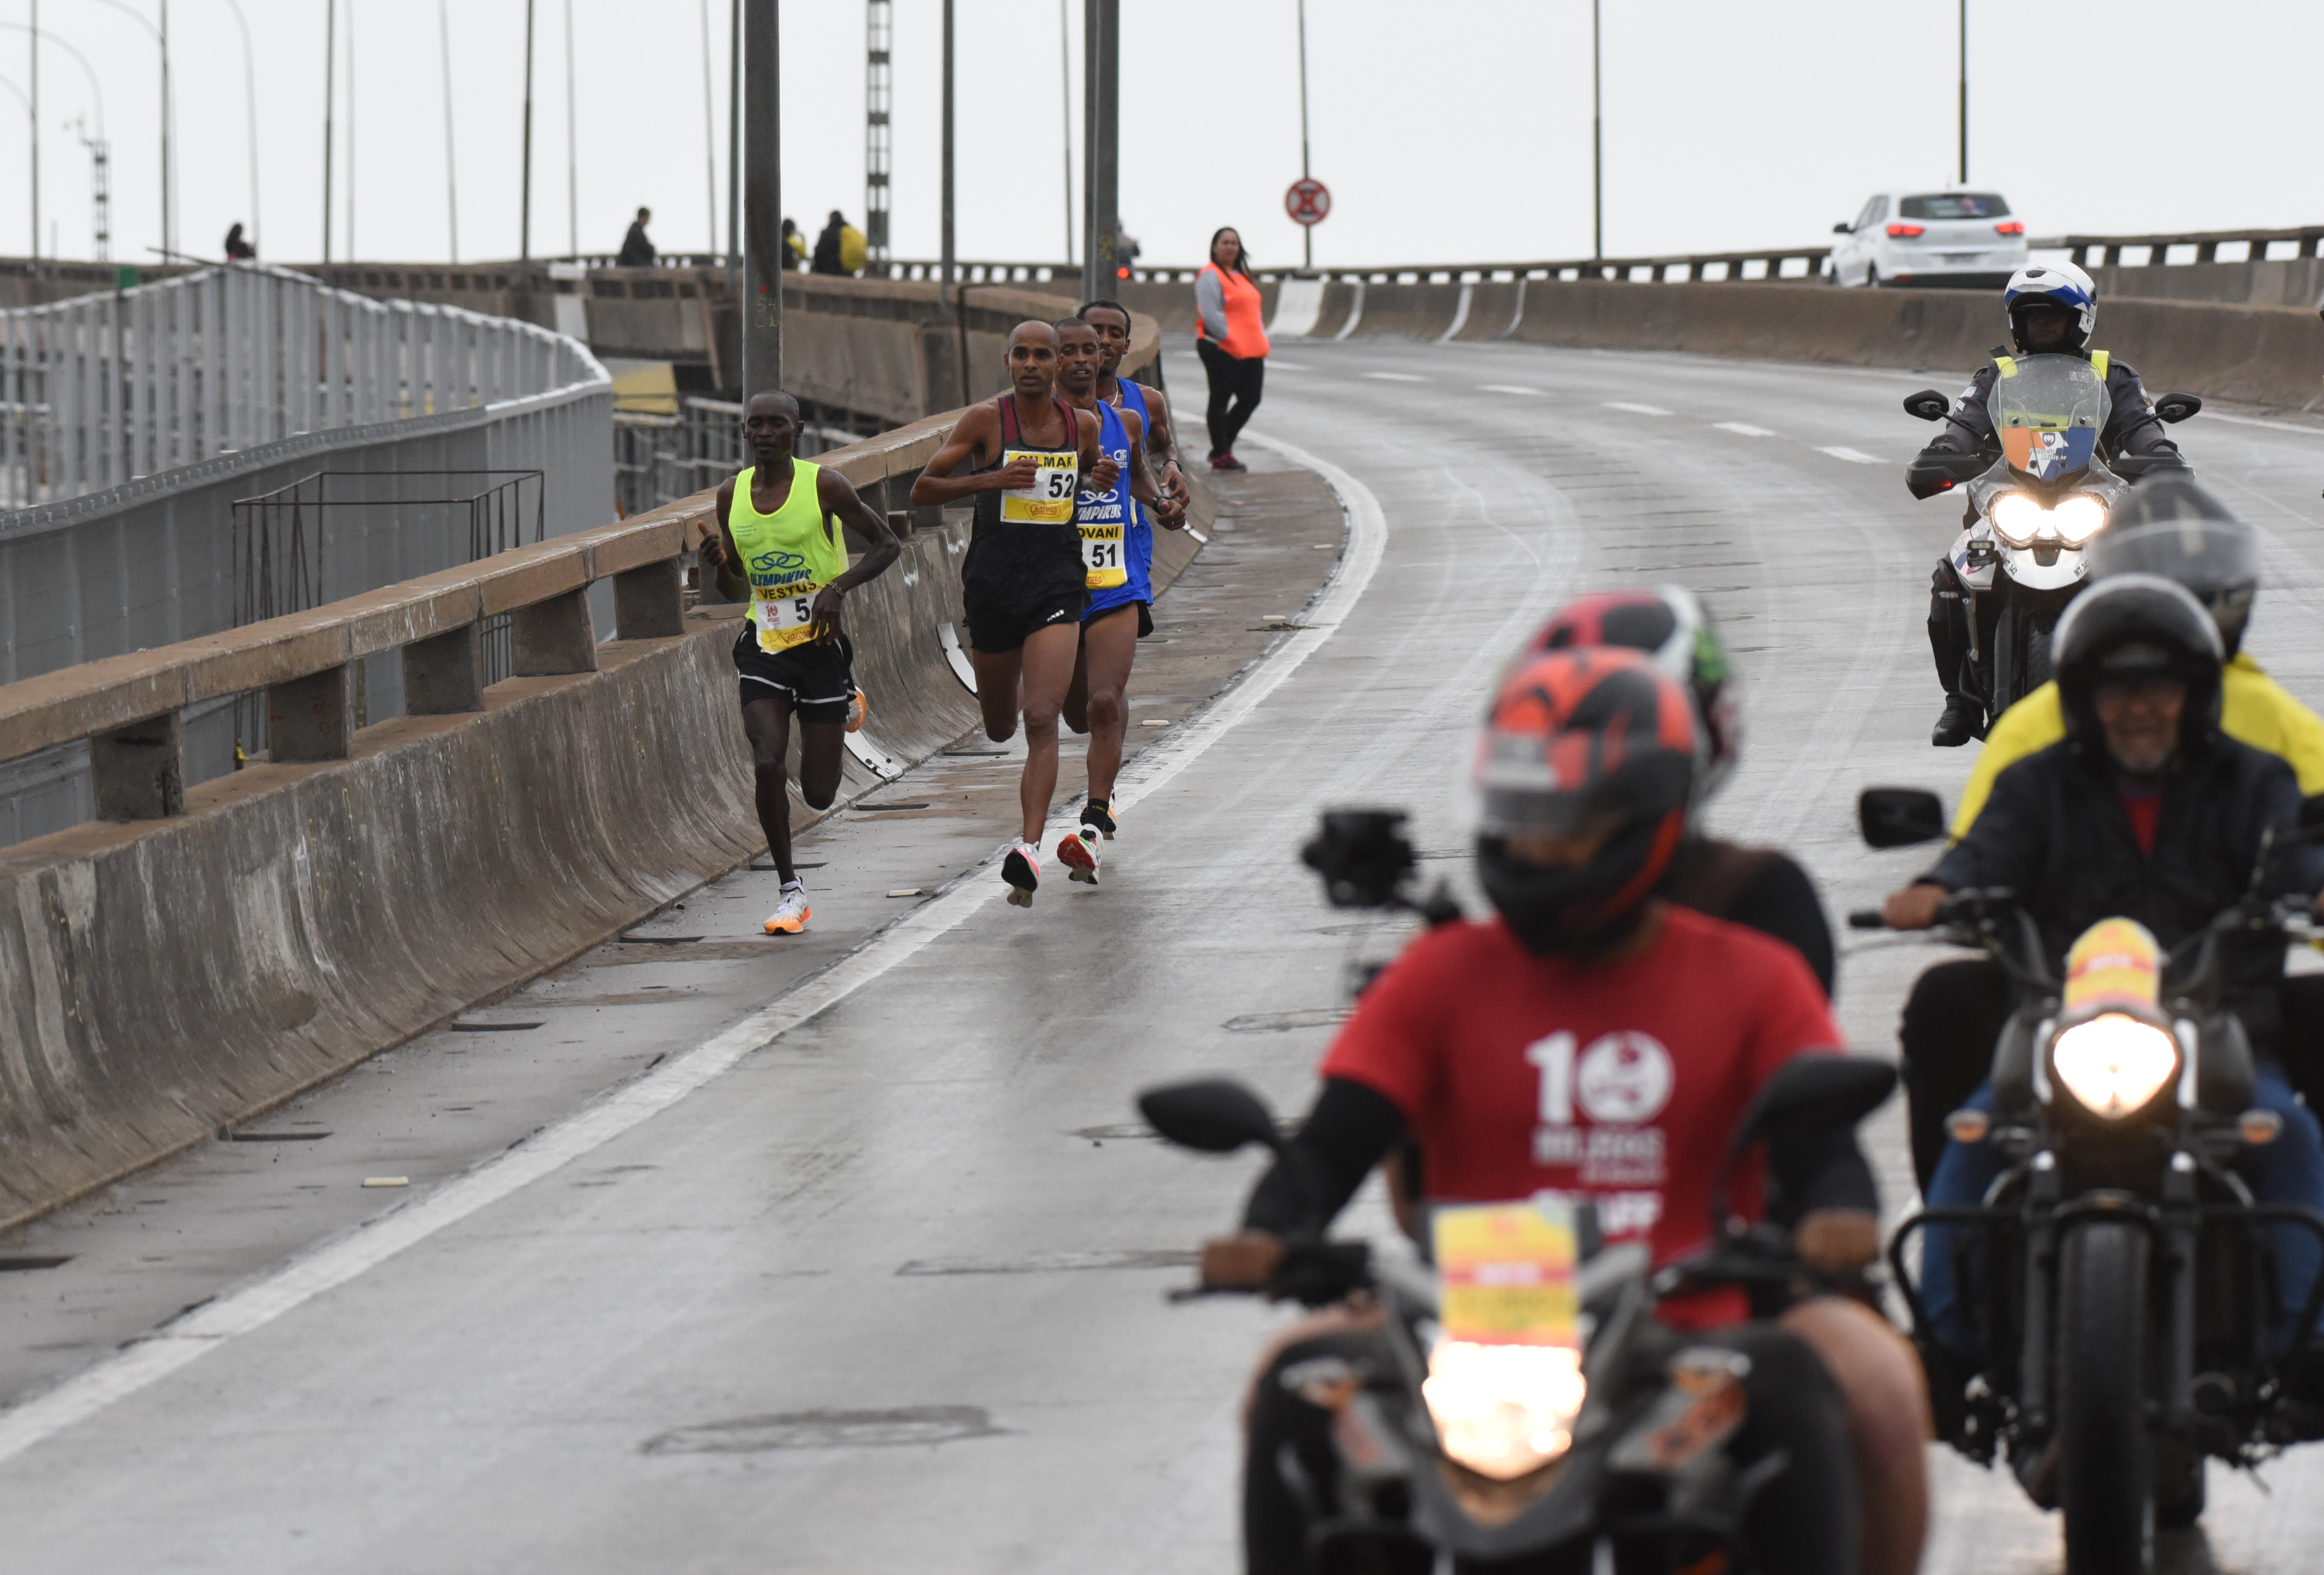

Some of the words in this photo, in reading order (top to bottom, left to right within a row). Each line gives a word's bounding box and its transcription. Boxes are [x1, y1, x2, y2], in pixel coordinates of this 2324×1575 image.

[1017, 455, 1072, 468] LMAR
[1048, 474, 1074, 498] 52
[1092, 544, 1115, 567] 51
[2009, 564, 2018, 575] 342
[2074, 566, 2082, 577] MT
[760, 582, 817, 600] VESTUS
[1523, 1029, 1676, 1124] 10
